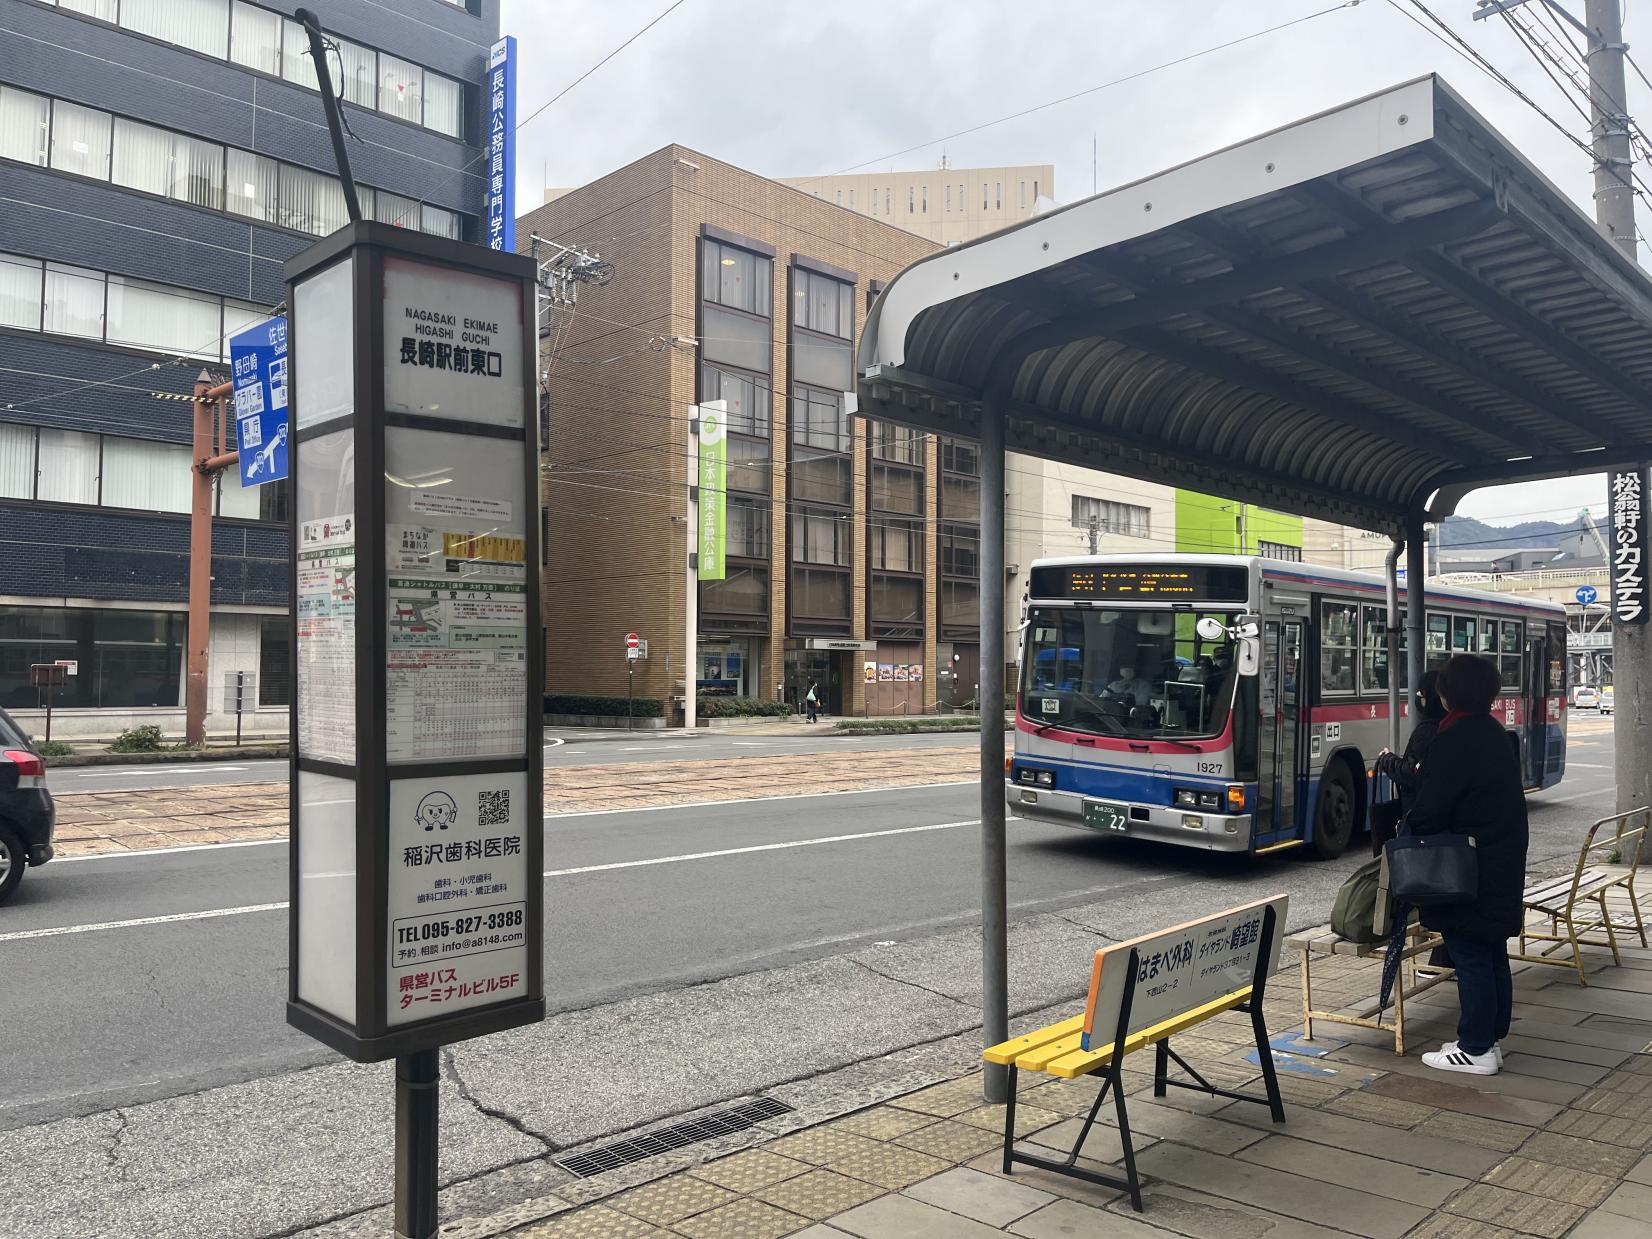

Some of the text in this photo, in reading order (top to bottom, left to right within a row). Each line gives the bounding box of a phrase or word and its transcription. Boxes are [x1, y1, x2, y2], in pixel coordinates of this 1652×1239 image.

[490, 69, 505, 251] 長崎公務員専門学校
[268, 322, 288, 345] 佐世
[405, 307, 499, 334] NAGASAKI EKIMAE
[415, 323, 490, 346] HIGASHI GUCHI
[400, 336, 502, 378] 長崎駅前東口
[1612, 472, 1643, 622] 松翁軒のカステラ
[1505, 699, 1516, 710] BUS
[1197, 762, 1223, 775] 1927
[403, 835, 521, 868] 稲沢歯科医院
[442, 932, 523, 953] info@a8148.com
[1137, 938, 1195, 984] はまべ外科
[399, 968, 458, 993] 県営バス
[400, 973, 520, 1010] ターミナルビル5F
